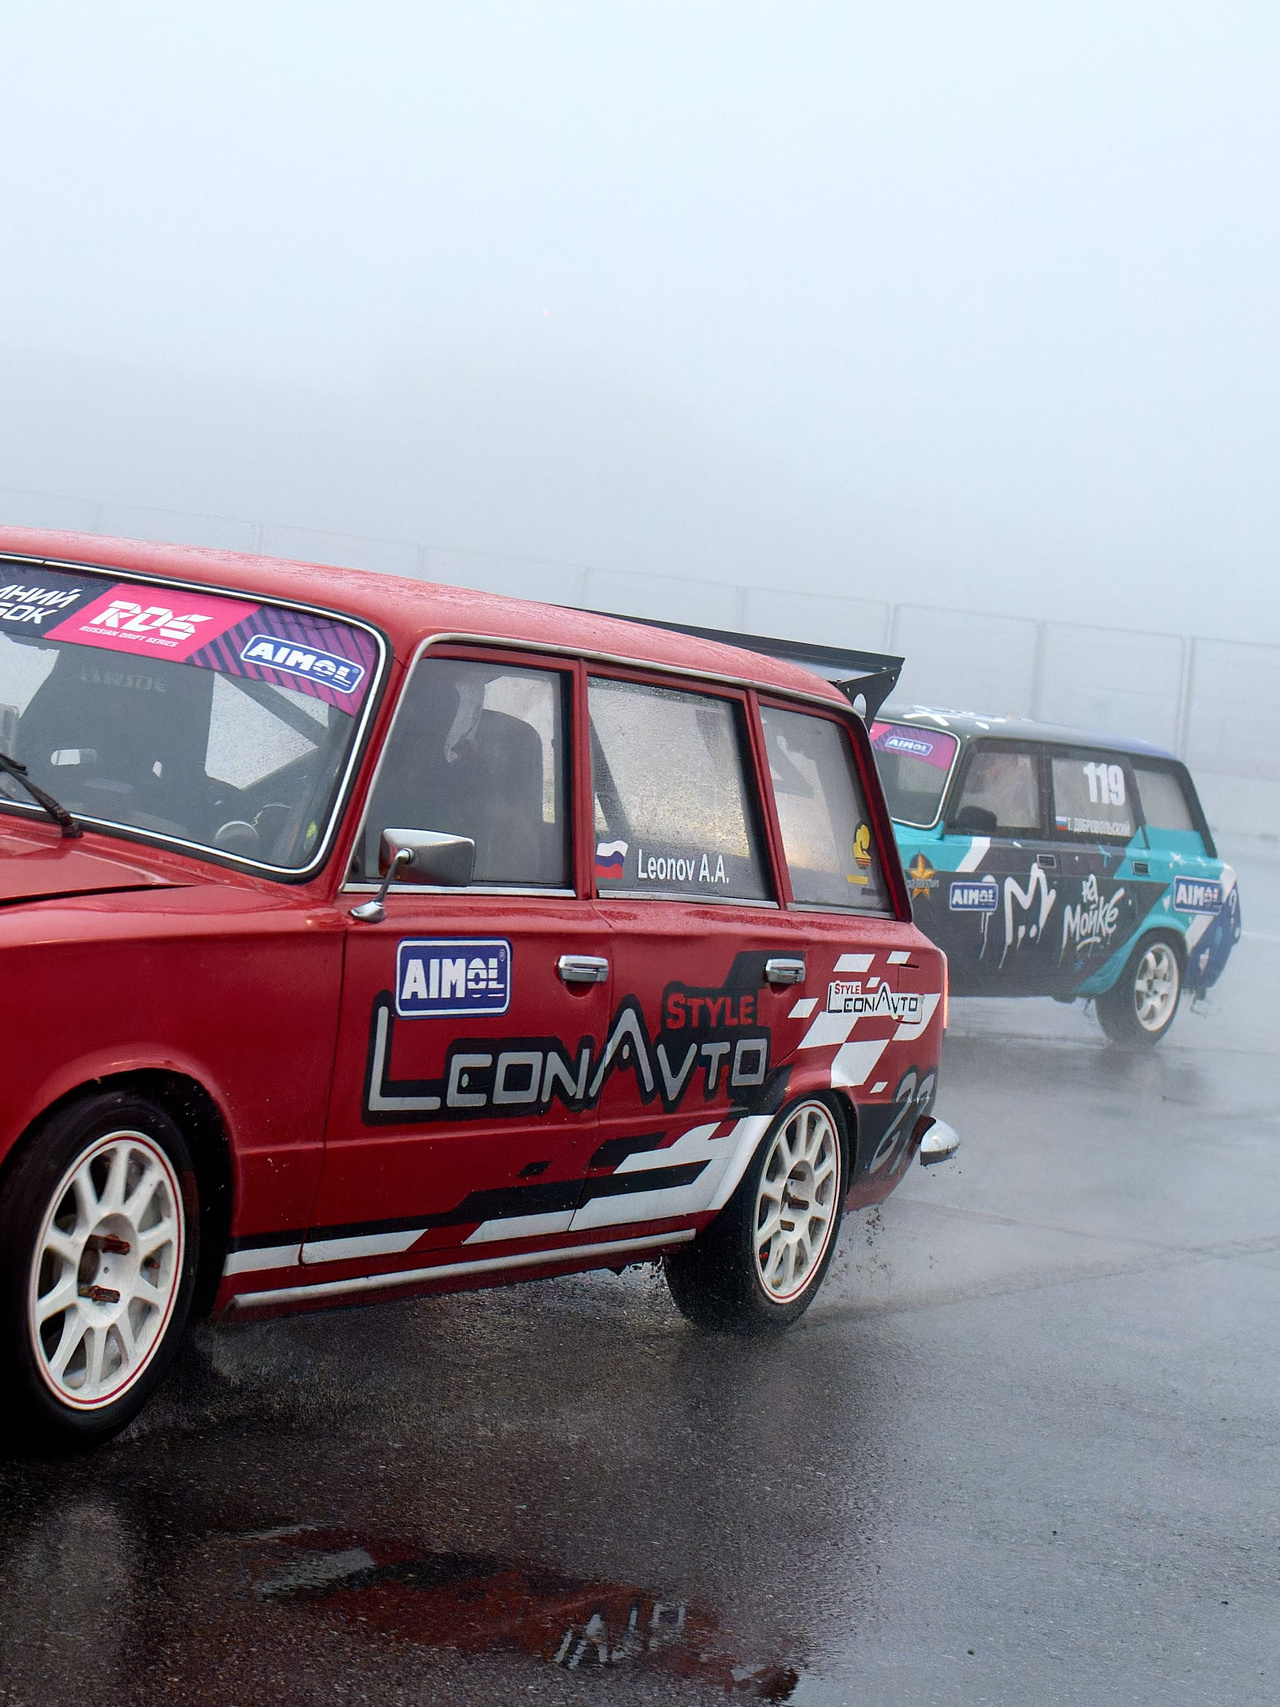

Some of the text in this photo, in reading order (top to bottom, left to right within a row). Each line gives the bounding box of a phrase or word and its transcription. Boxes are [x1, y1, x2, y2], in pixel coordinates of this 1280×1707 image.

[79, 625, 179, 648] RUSSIAN DRIFT SERIES
[89, 600, 214, 640] RDS
[246, 641, 354, 688] AIMOL
[1083, 761, 1126, 806] 119
[637, 849, 730, 884] Leonov A.A.
[951, 888, 996, 905] AIMOL
[401, 957, 505, 999] AIMOL
